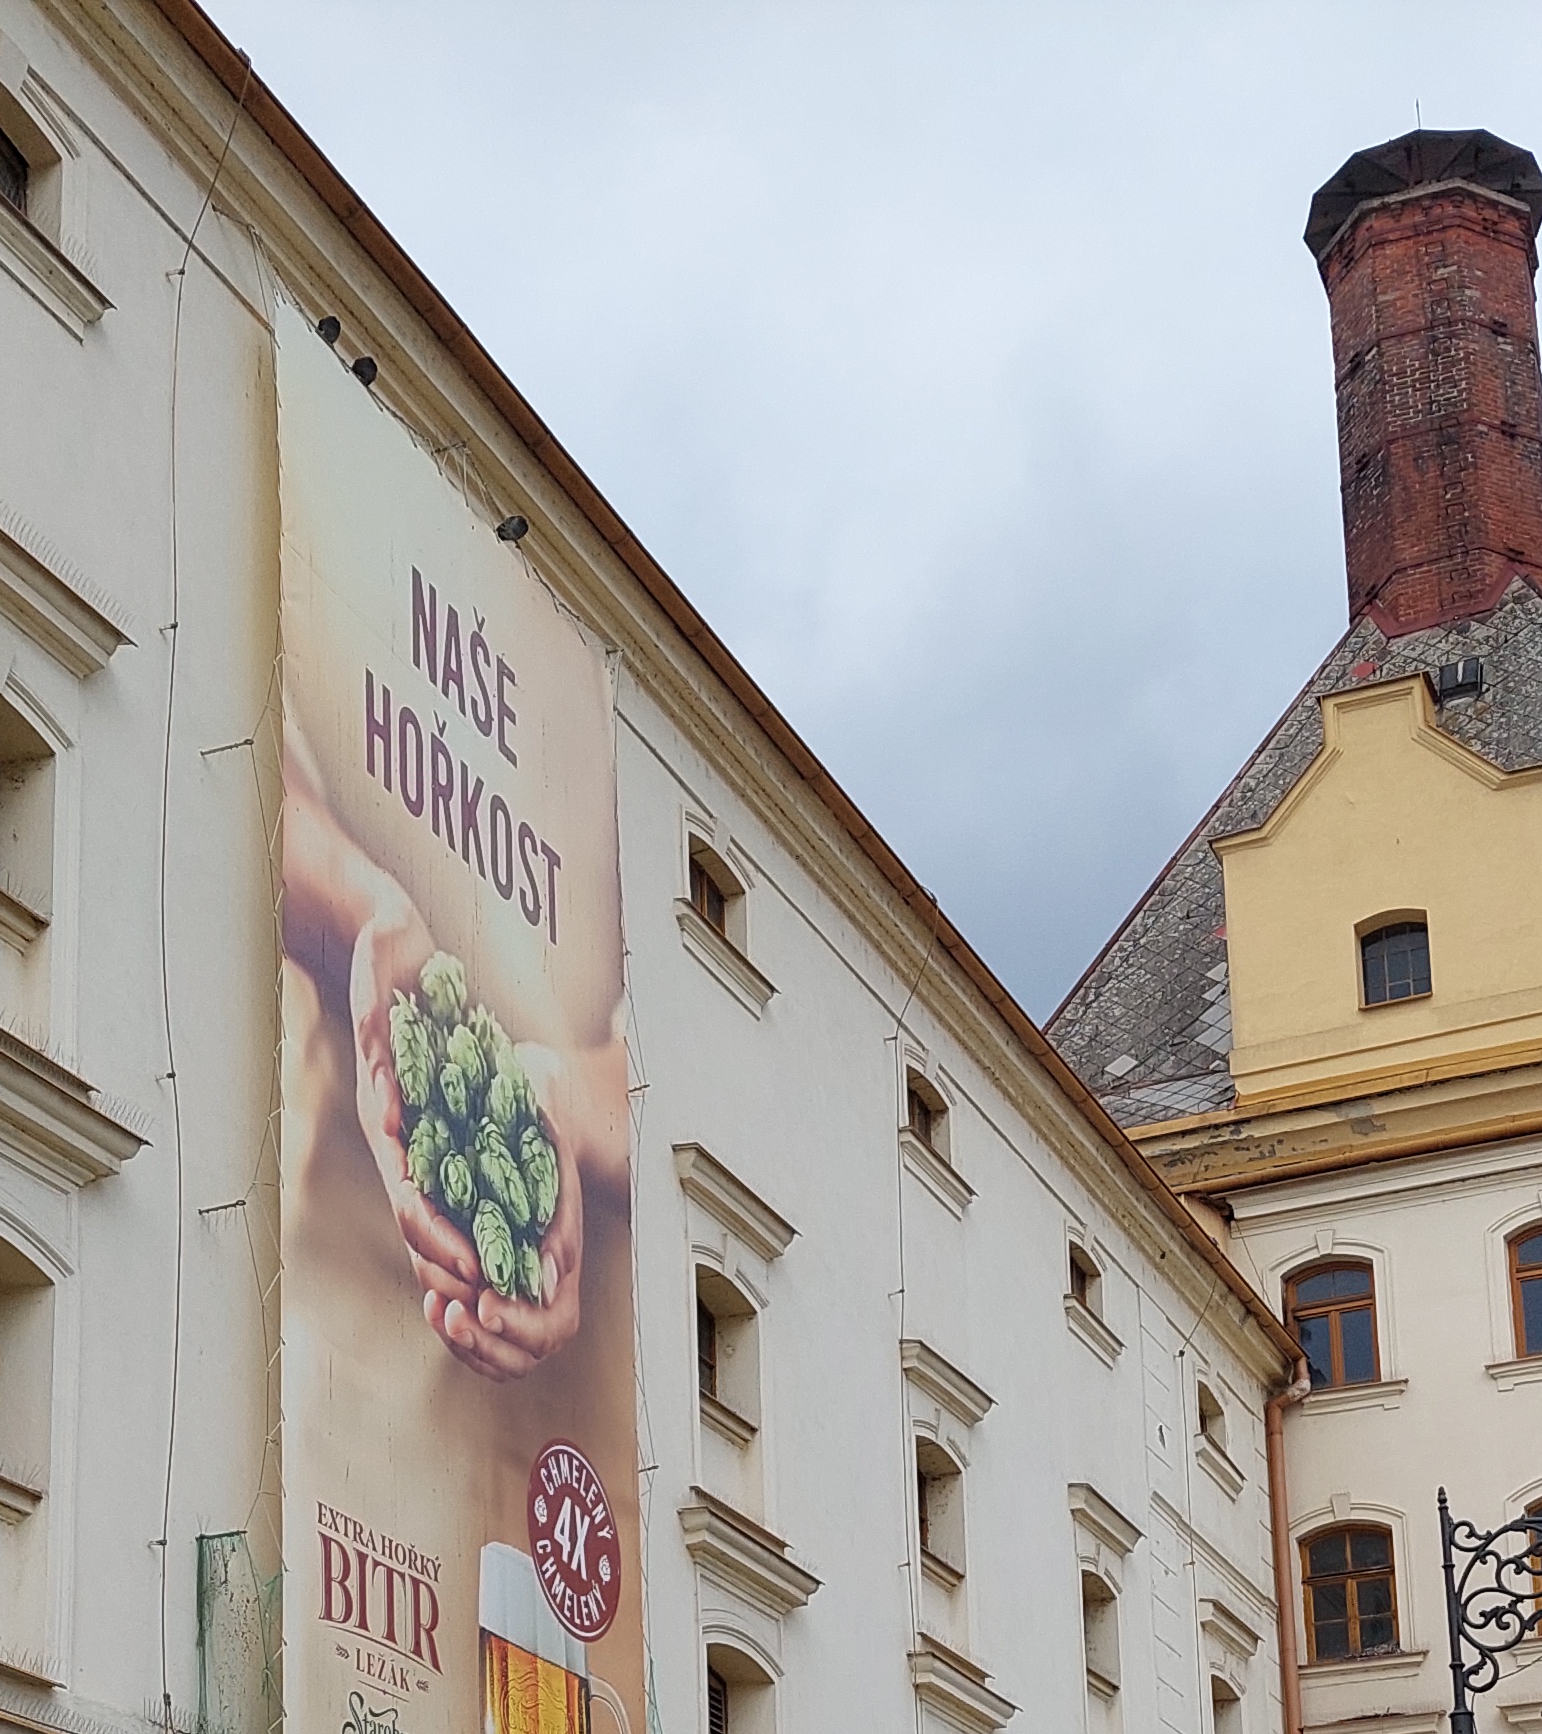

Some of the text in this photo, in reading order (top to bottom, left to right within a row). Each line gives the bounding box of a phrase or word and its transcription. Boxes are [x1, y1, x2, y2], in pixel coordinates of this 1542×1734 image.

[411, 564, 518, 769] NAŠE
[364, 667, 561, 946] HOŘKOST
[316, 1501, 442, 1584] EXTRA HOŘKÝ
[554, 1496, 590, 1581] 4X
[317, 1530, 444, 1676] BITR
[355, 1647, 410, 1692] LEŽÁK
